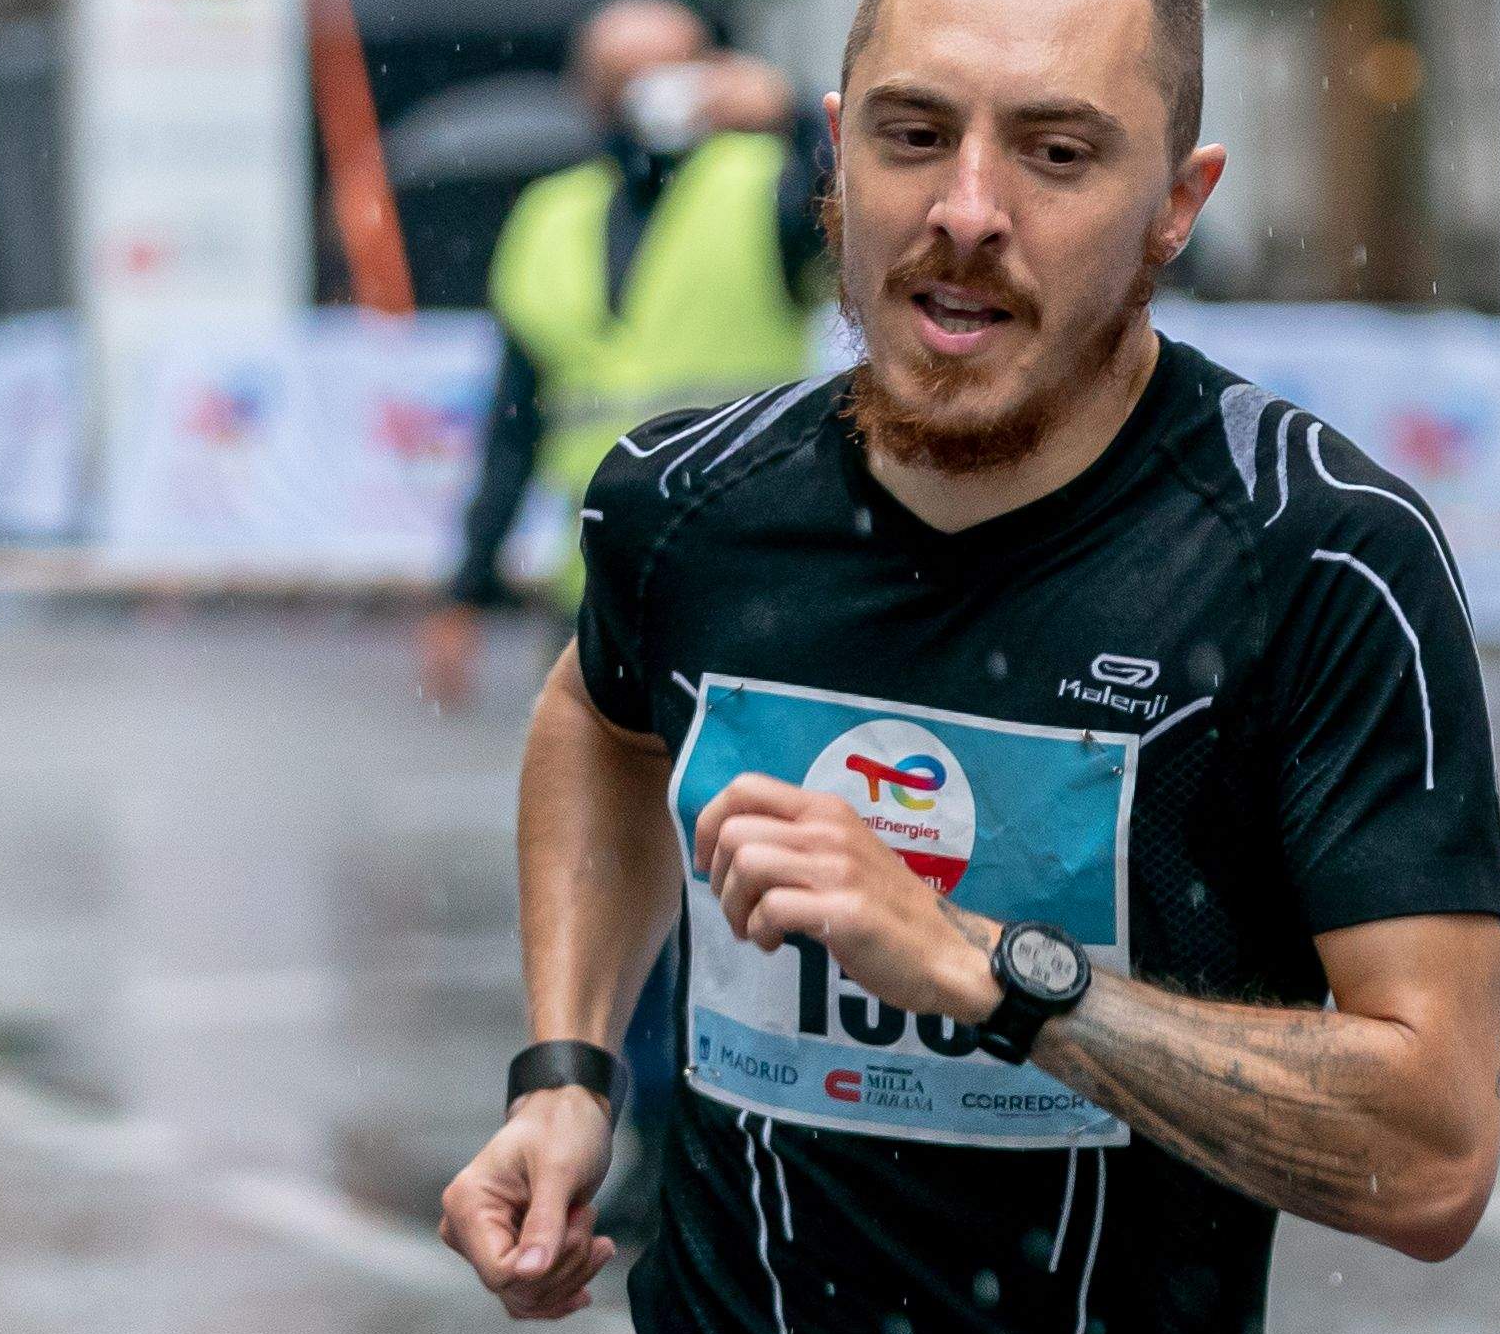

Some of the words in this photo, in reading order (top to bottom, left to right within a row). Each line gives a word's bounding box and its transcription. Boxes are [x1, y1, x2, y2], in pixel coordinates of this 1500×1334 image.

[1057, 678, 1169, 721] Kalenji
[862, 815, 941, 841] alEnergies
[720, 1044, 800, 1086] MADRID
[866, 1071, 926, 1094] MILLA
[865, 1089, 934, 1113] URBANA
[960, 1092, 1087, 1113] CORREDOR
